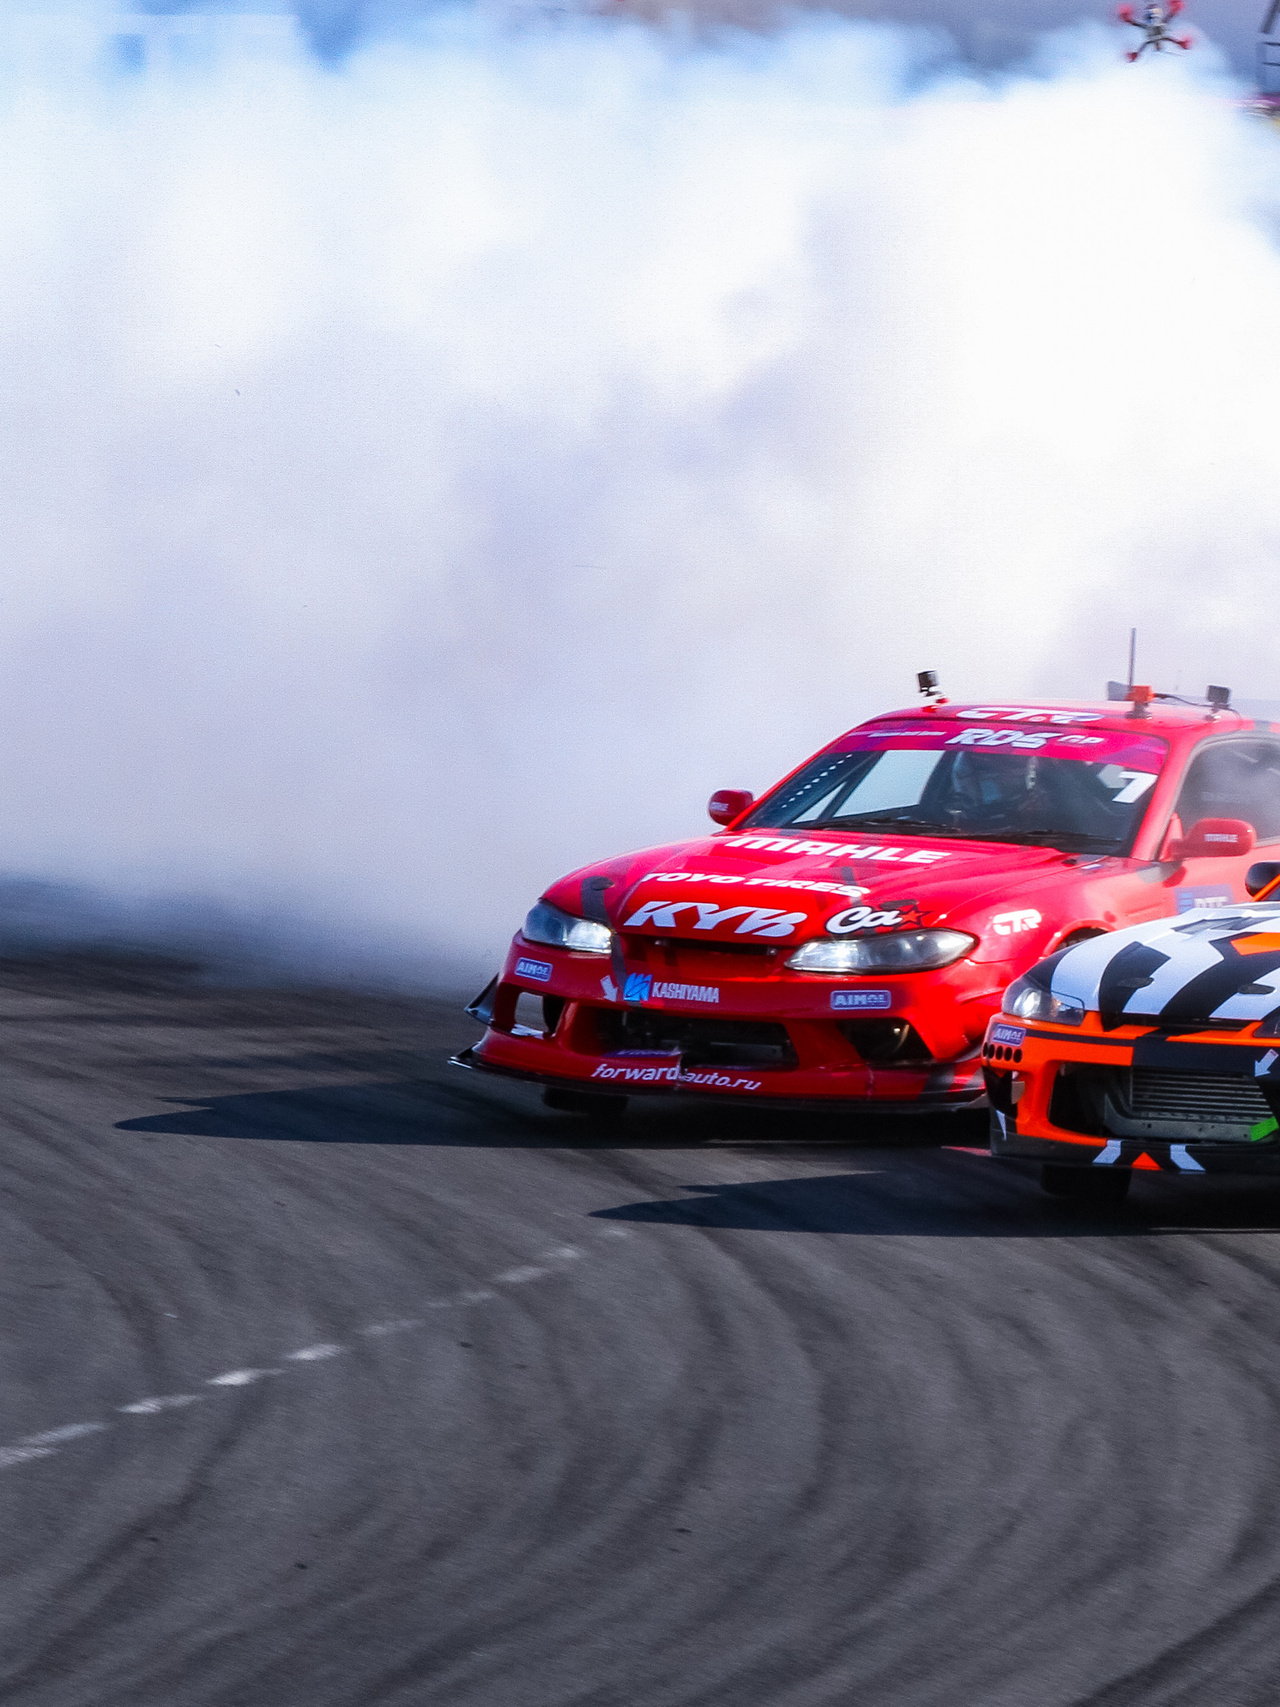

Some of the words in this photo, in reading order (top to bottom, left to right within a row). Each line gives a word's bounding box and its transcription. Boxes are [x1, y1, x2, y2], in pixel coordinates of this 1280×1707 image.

[945, 728, 1064, 749] RDS
[724, 837, 952, 864] MAHLE
[641, 872, 746, 884] TOYO
[744, 878, 871, 898] TIRES
[623, 901, 808, 938] KYB
[993, 909, 1042, 935] CTR
[652, 981, 720, 1004] KASHIYAMA
[834, 994, 887, 1006] AIMOL
